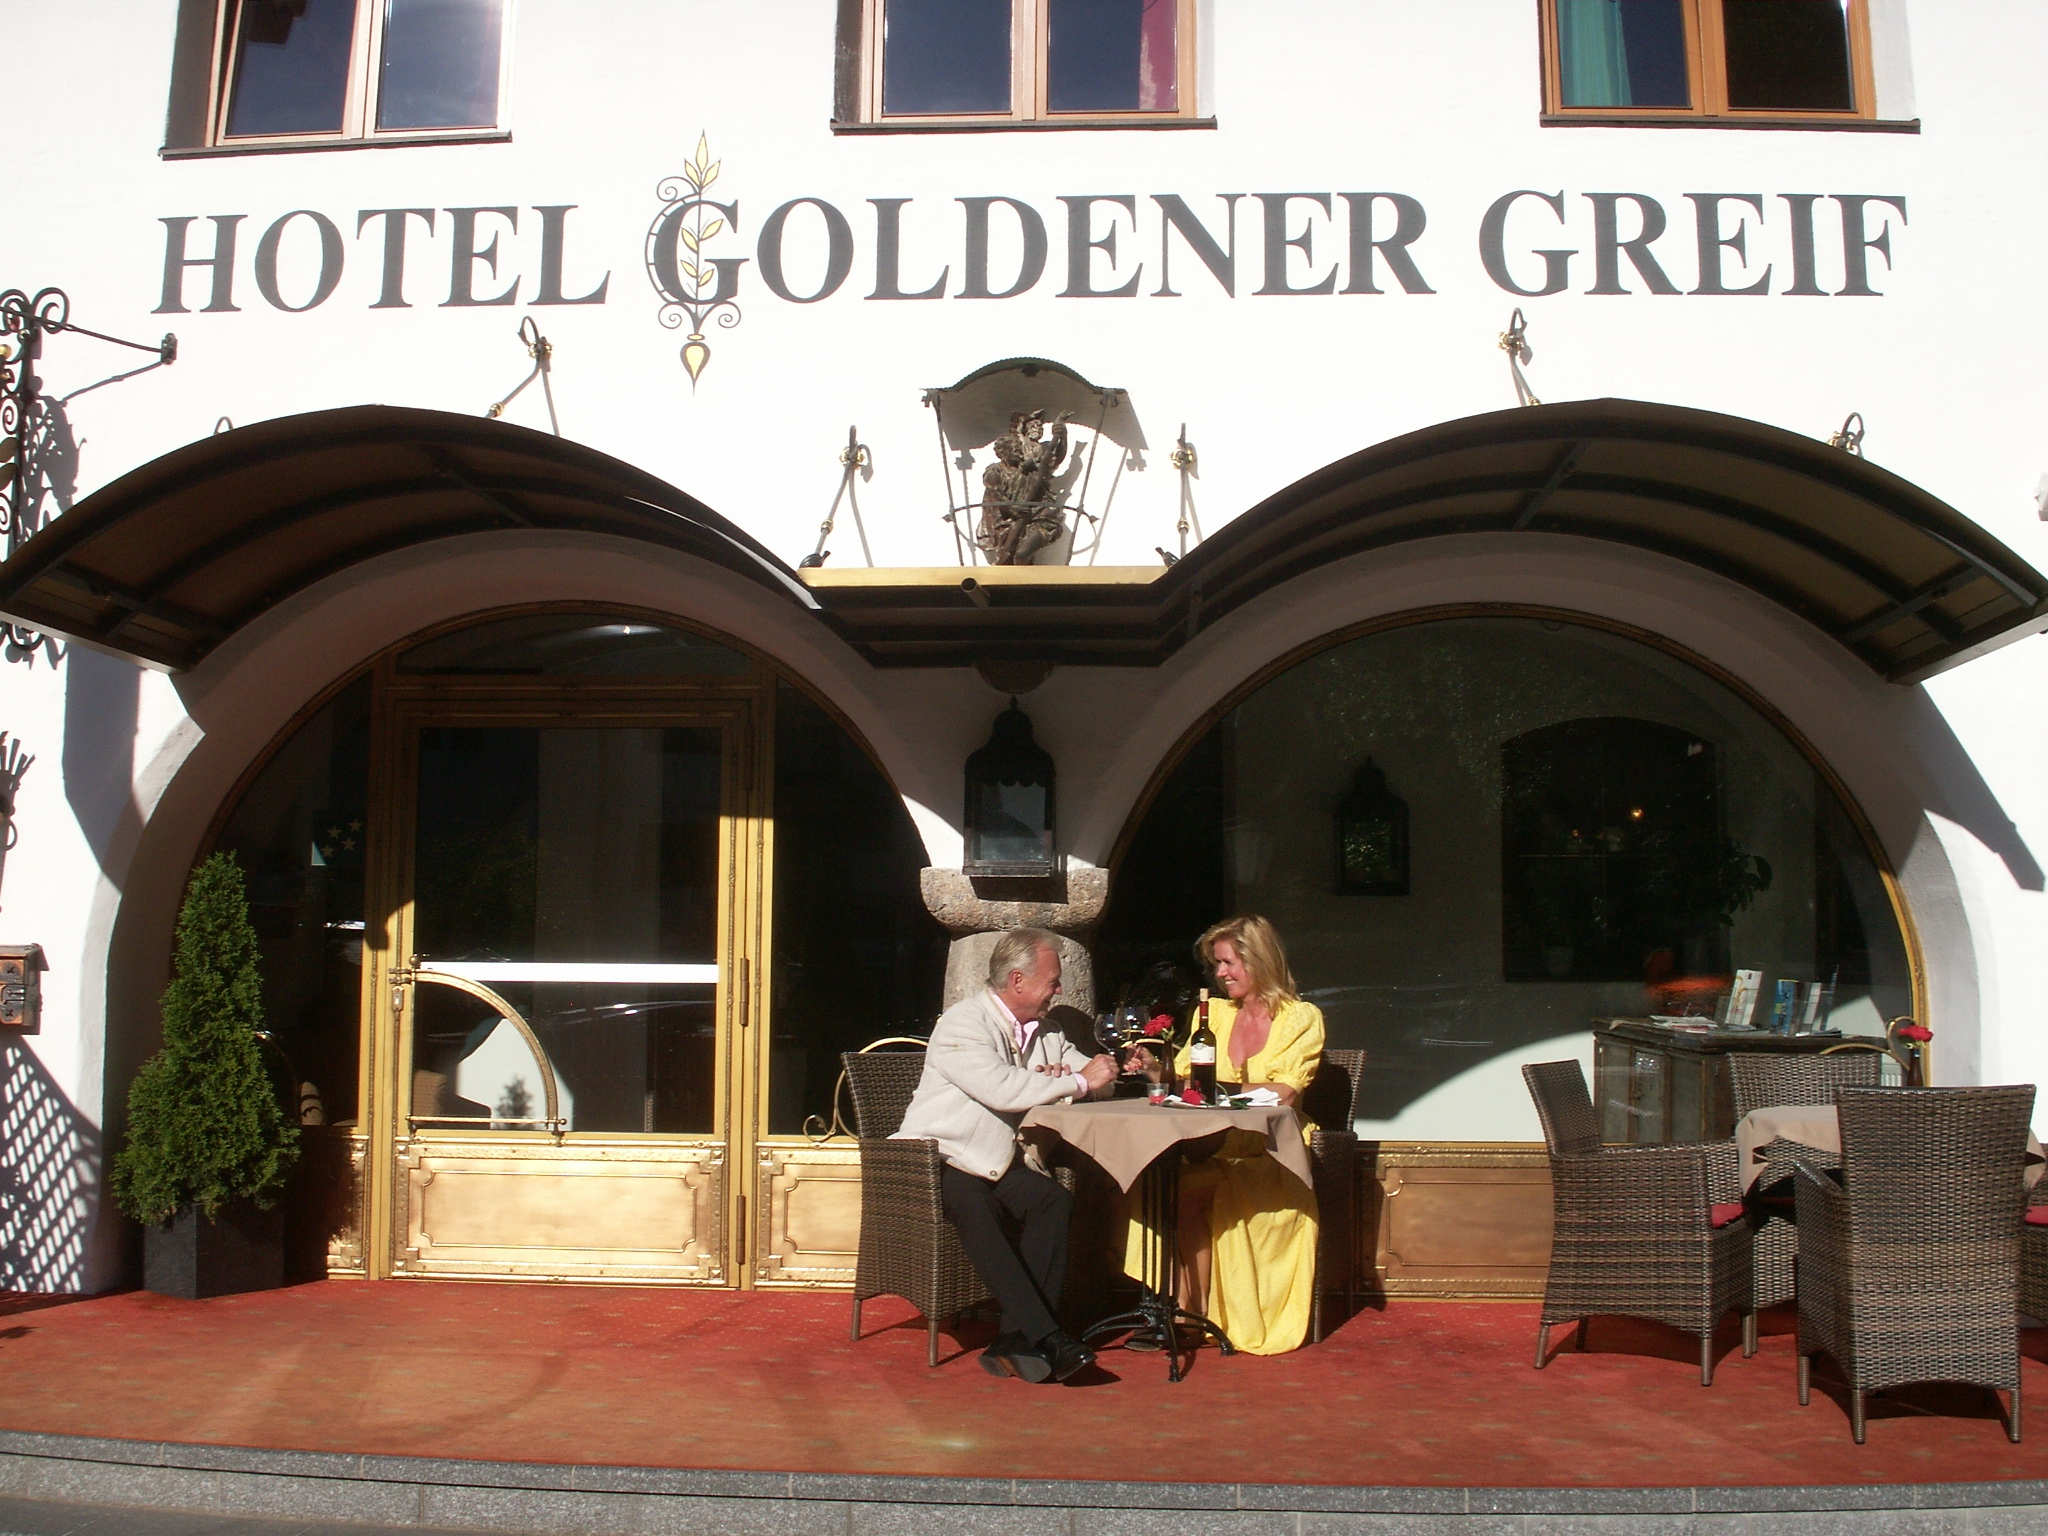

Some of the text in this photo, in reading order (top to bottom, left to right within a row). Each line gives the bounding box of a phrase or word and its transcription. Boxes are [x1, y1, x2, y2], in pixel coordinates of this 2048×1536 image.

[151, 190, 1908, 314] HOTEL GOLDENER GREIF
